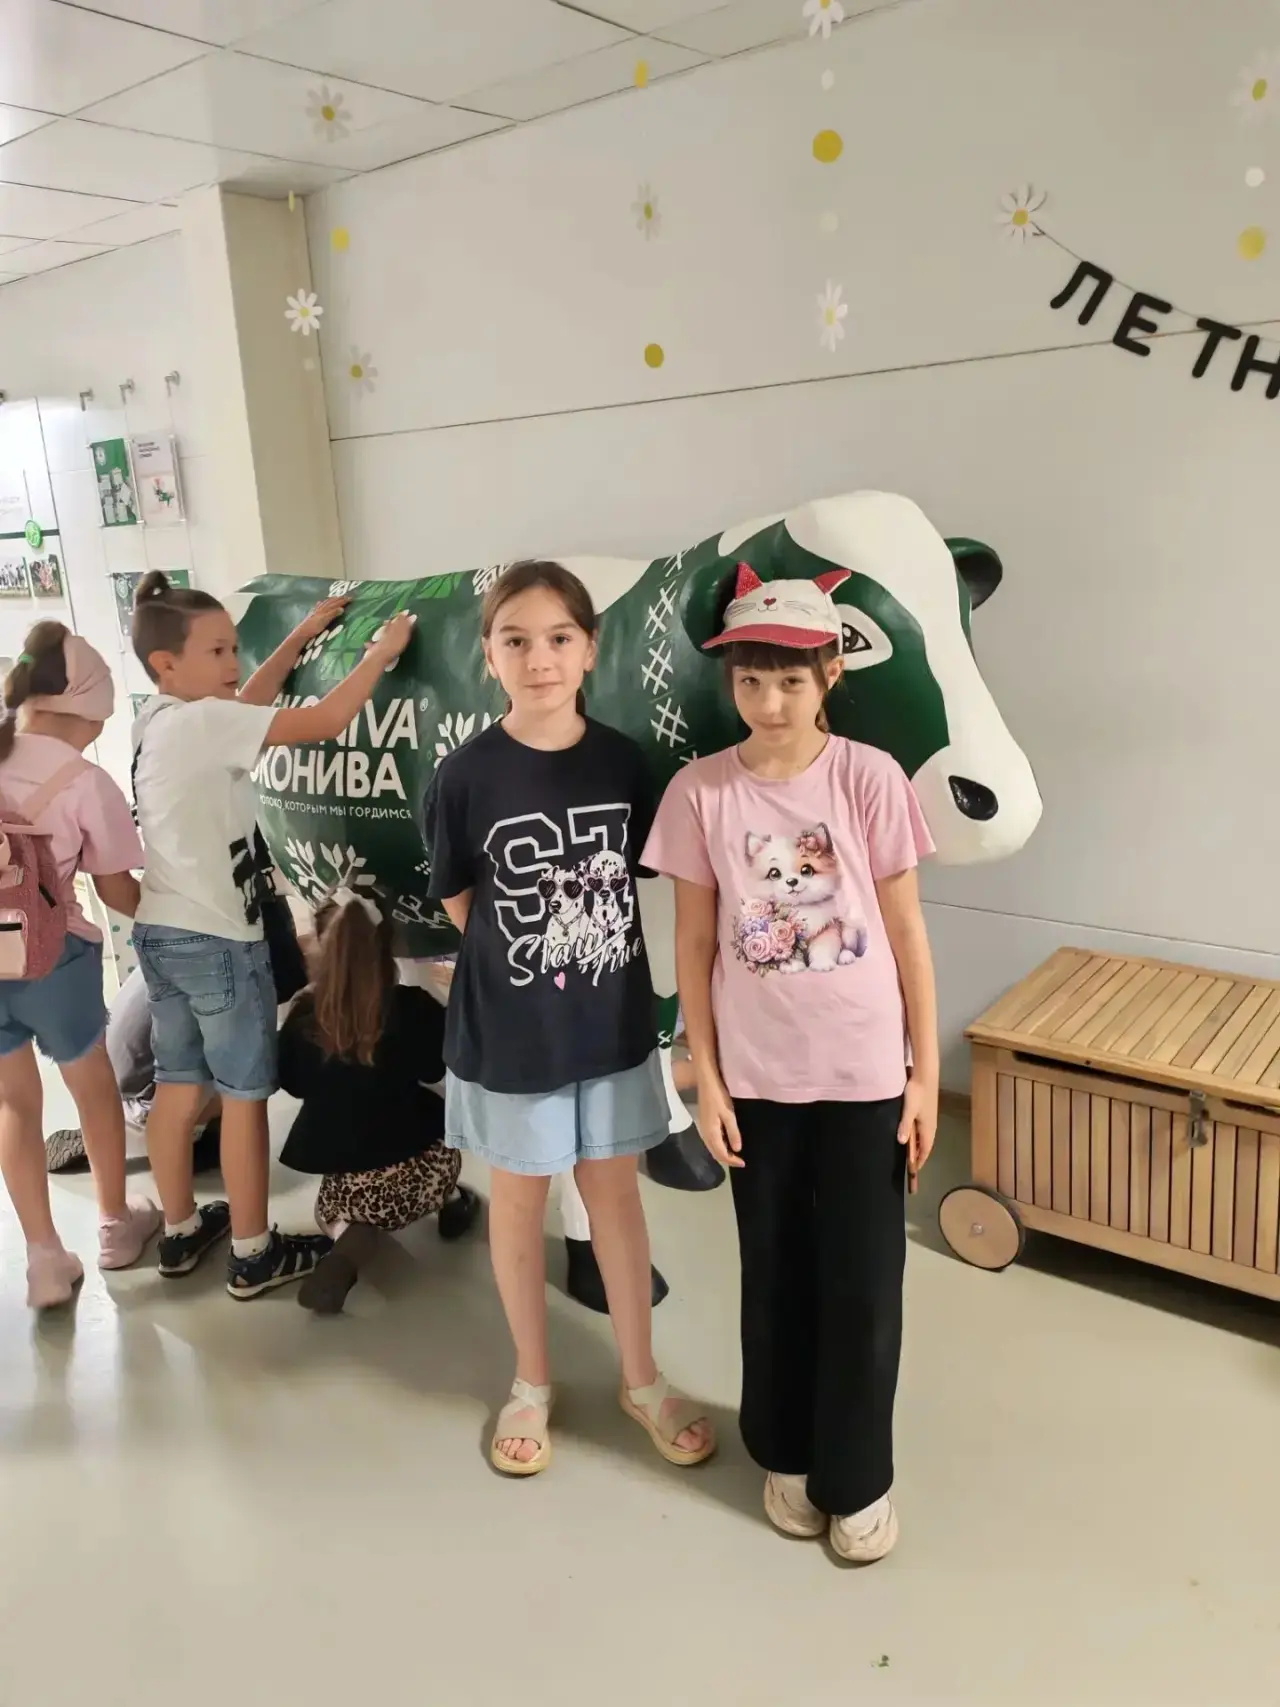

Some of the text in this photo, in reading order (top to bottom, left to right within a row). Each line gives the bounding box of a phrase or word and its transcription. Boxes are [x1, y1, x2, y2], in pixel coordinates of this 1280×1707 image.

[250, 745, 407, 800] КОНИВА
[284, 800, 327, 815] КОТОРЫМ
[330, 805, 346, 816] МЫ
[349, 806, 413, 819] ГОРДИМСЯ
